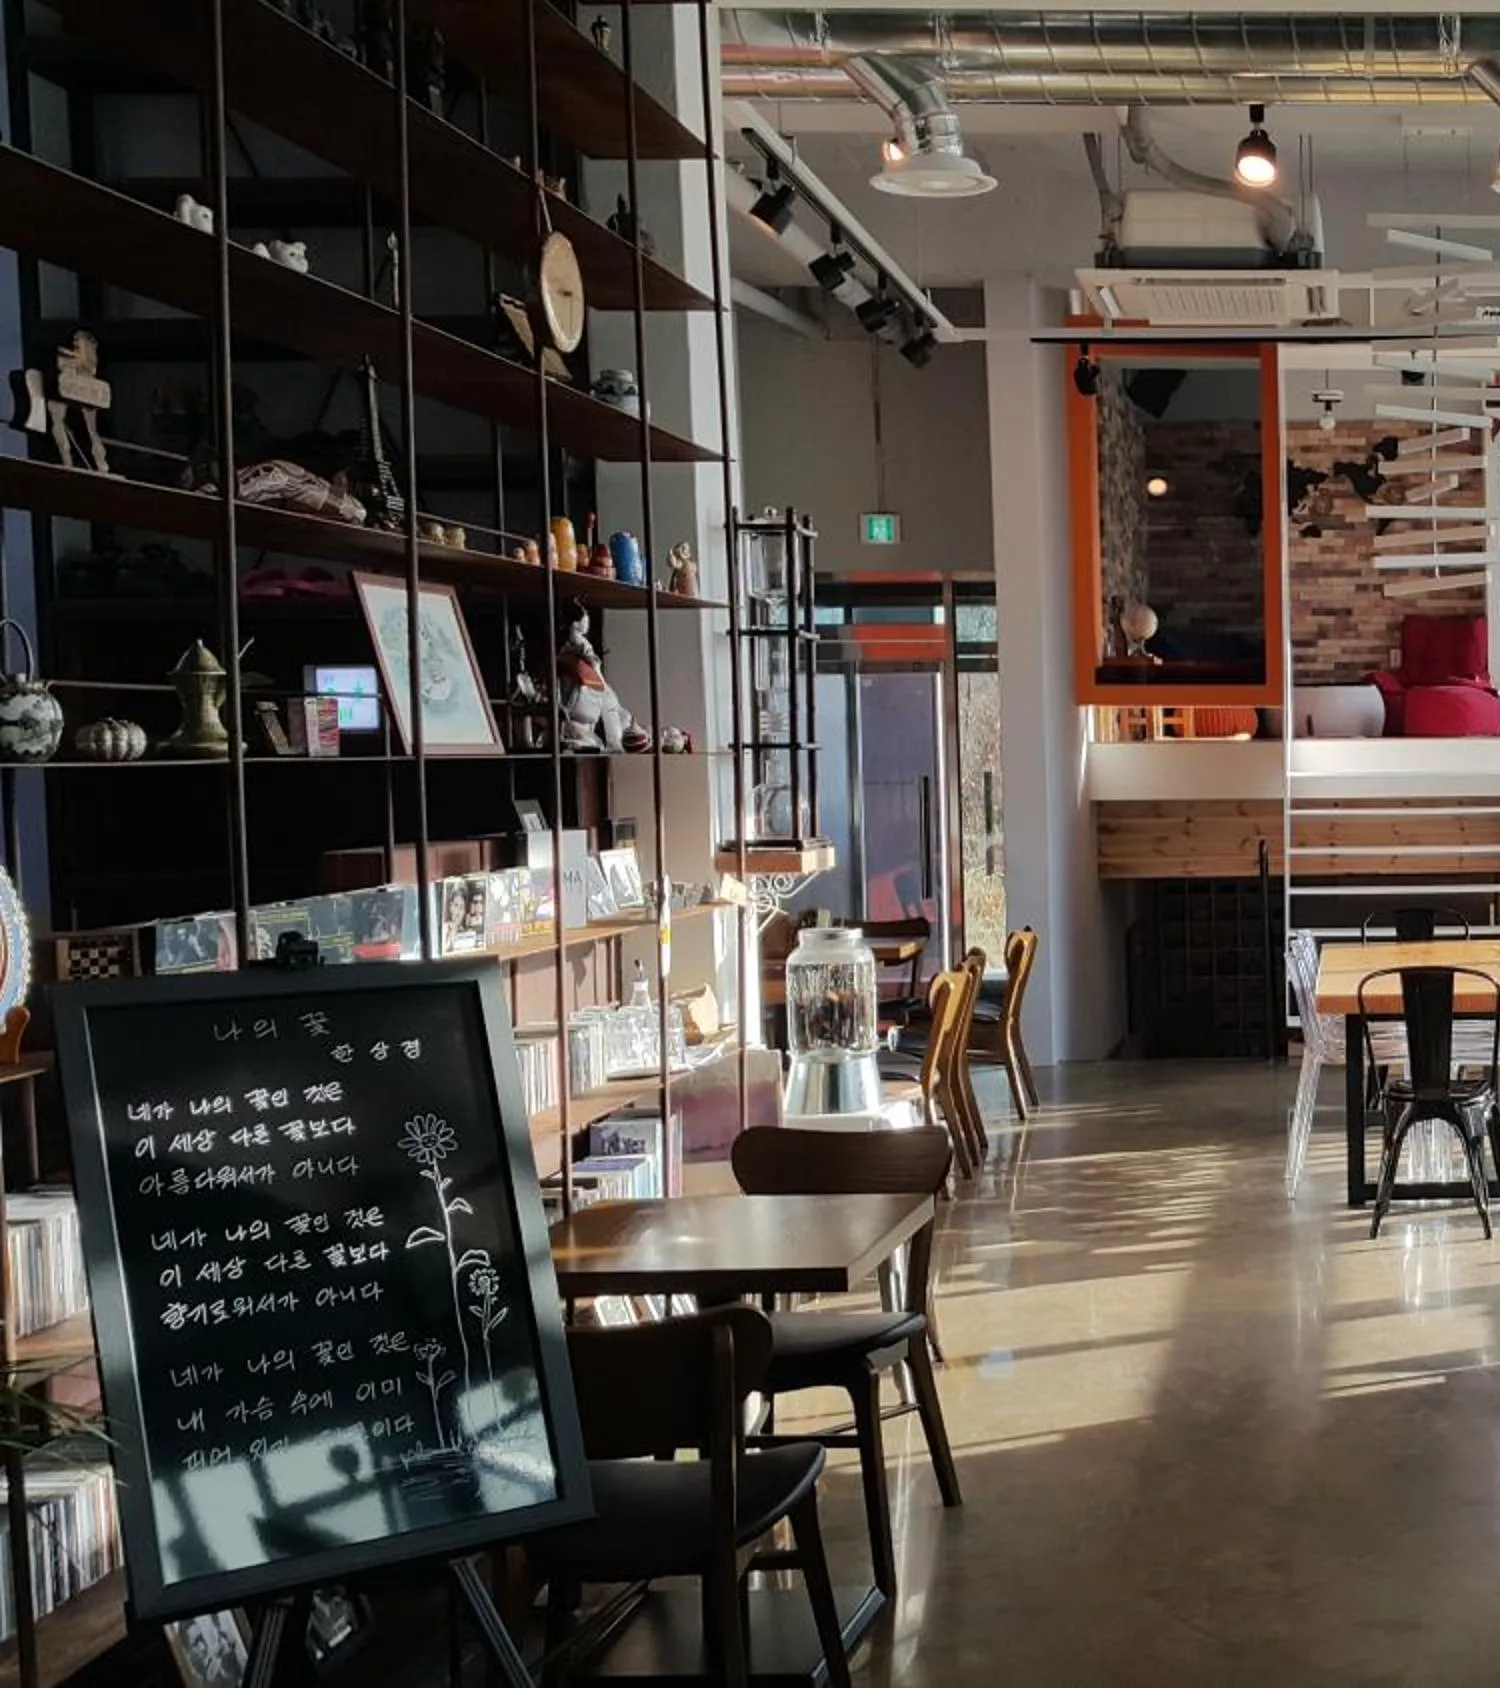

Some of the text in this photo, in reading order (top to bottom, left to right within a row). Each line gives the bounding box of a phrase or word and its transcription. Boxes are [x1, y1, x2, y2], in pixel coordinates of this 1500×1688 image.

[213, 1010, 332, 1041] 나의 꽃
[127, 1080, 345, 1123] 네가 나의 꽃인 것은
[134, 1116, 357, 1160] 이 세상 다른 꽃보다
[139, 1155, 360, 1197] 아름다워서가 아니다
[151, 1206, 385, 1251] 네가 나의 꽃인 것은
[160, 1241, 390, 1288] 이 세상 다른 꽃보다
[160, 1281, 385, 1330] 향기로워서가 아니다
[170, 1331, 411, 1388] 네가 나의 꽃인 것은
[177, 1376, 402, 1433] 내 가슴 속에 이미
